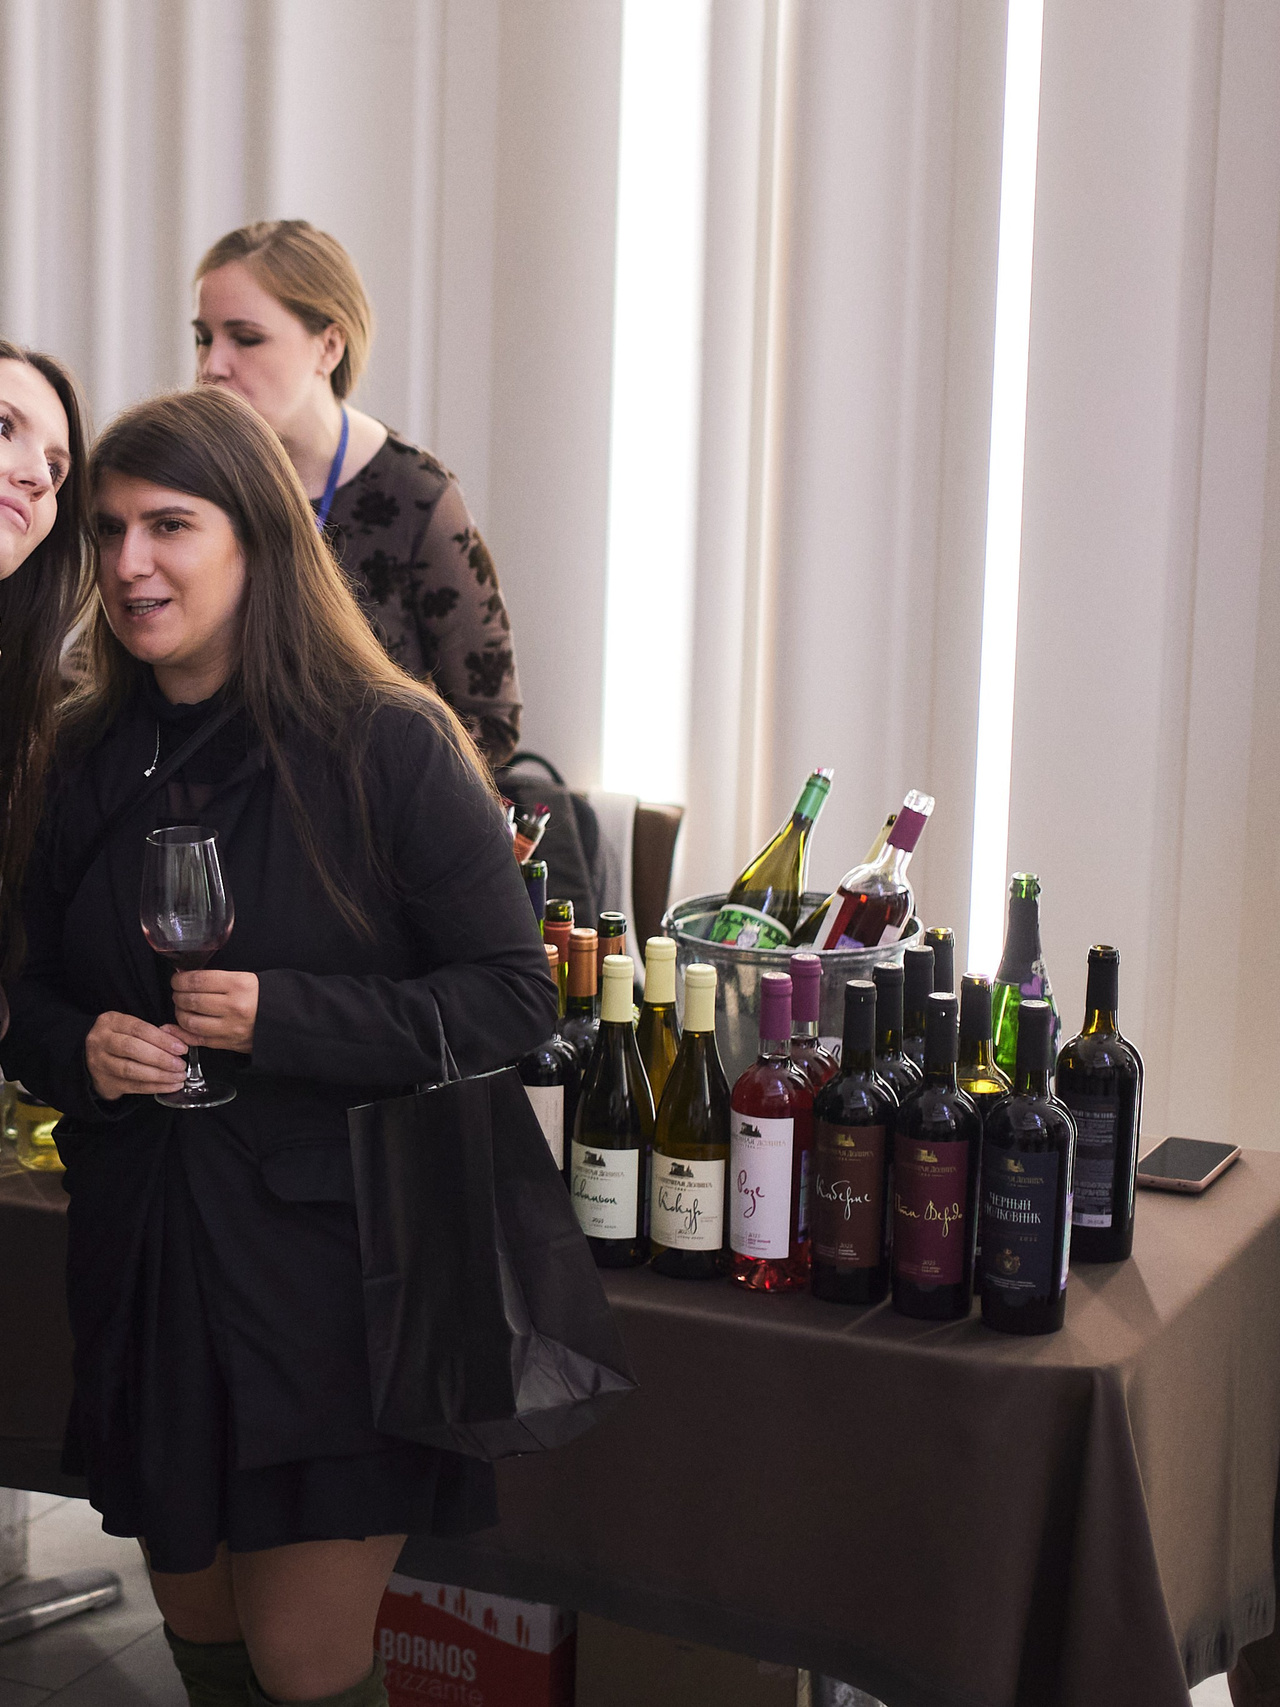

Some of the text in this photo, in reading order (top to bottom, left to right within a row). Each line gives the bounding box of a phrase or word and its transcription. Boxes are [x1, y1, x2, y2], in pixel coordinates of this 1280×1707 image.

[658, 1186, 703, 1235] Кокур
[737, 1169, 765, 1219] Розе
[816, 1173, 872, 1221] Каберне
[924, 1200, 963, 1238] Вердо
[379, 1627, 477, 1682] BORNOS
